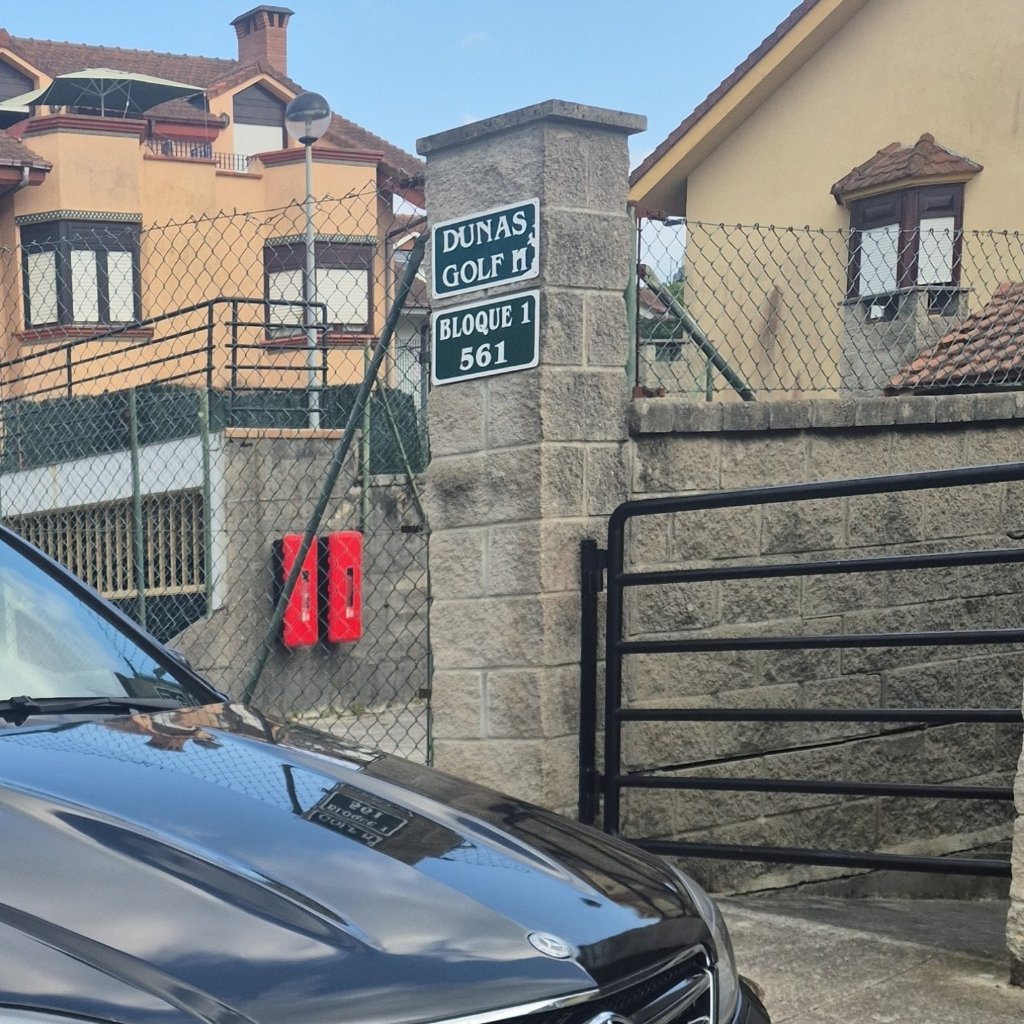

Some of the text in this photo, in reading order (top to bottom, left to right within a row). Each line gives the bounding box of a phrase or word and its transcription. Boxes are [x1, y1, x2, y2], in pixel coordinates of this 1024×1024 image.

[443, 210, 527, 253] DUNAS
[442, 253, 504, 288] GOLF
[439, 302, 531, 341] BLOQUE 1
[459, 340, 508, 371] 561
